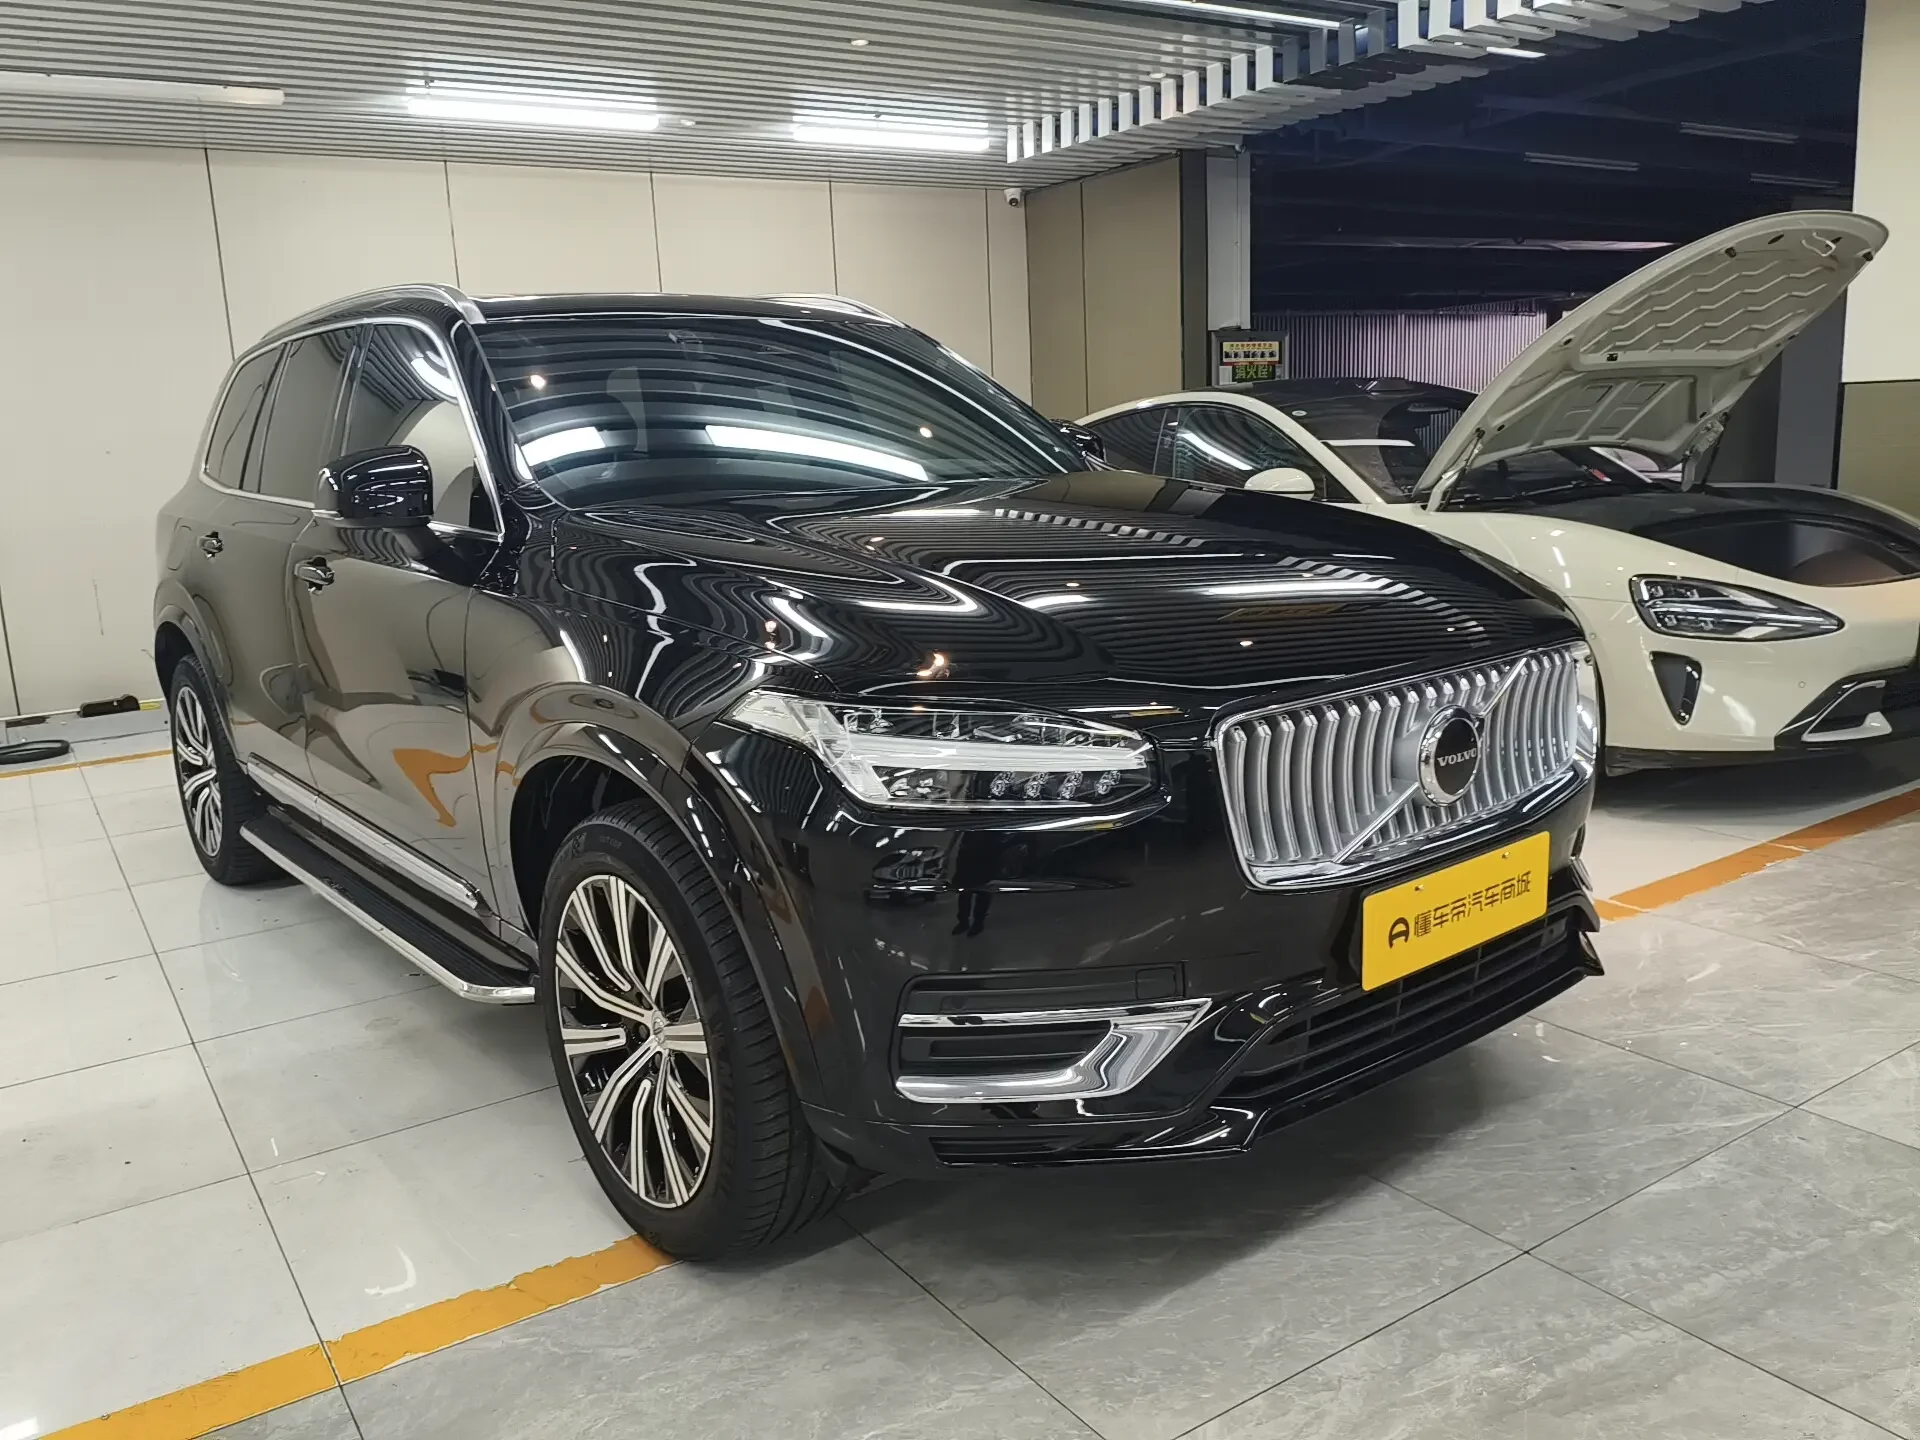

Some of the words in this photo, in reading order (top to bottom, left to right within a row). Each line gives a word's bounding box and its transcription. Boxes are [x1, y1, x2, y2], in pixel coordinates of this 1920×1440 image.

[1436, 747, 1477, 767] VOLVO
[1413, 869, 1533, 938] 懂车帝汽车商城
